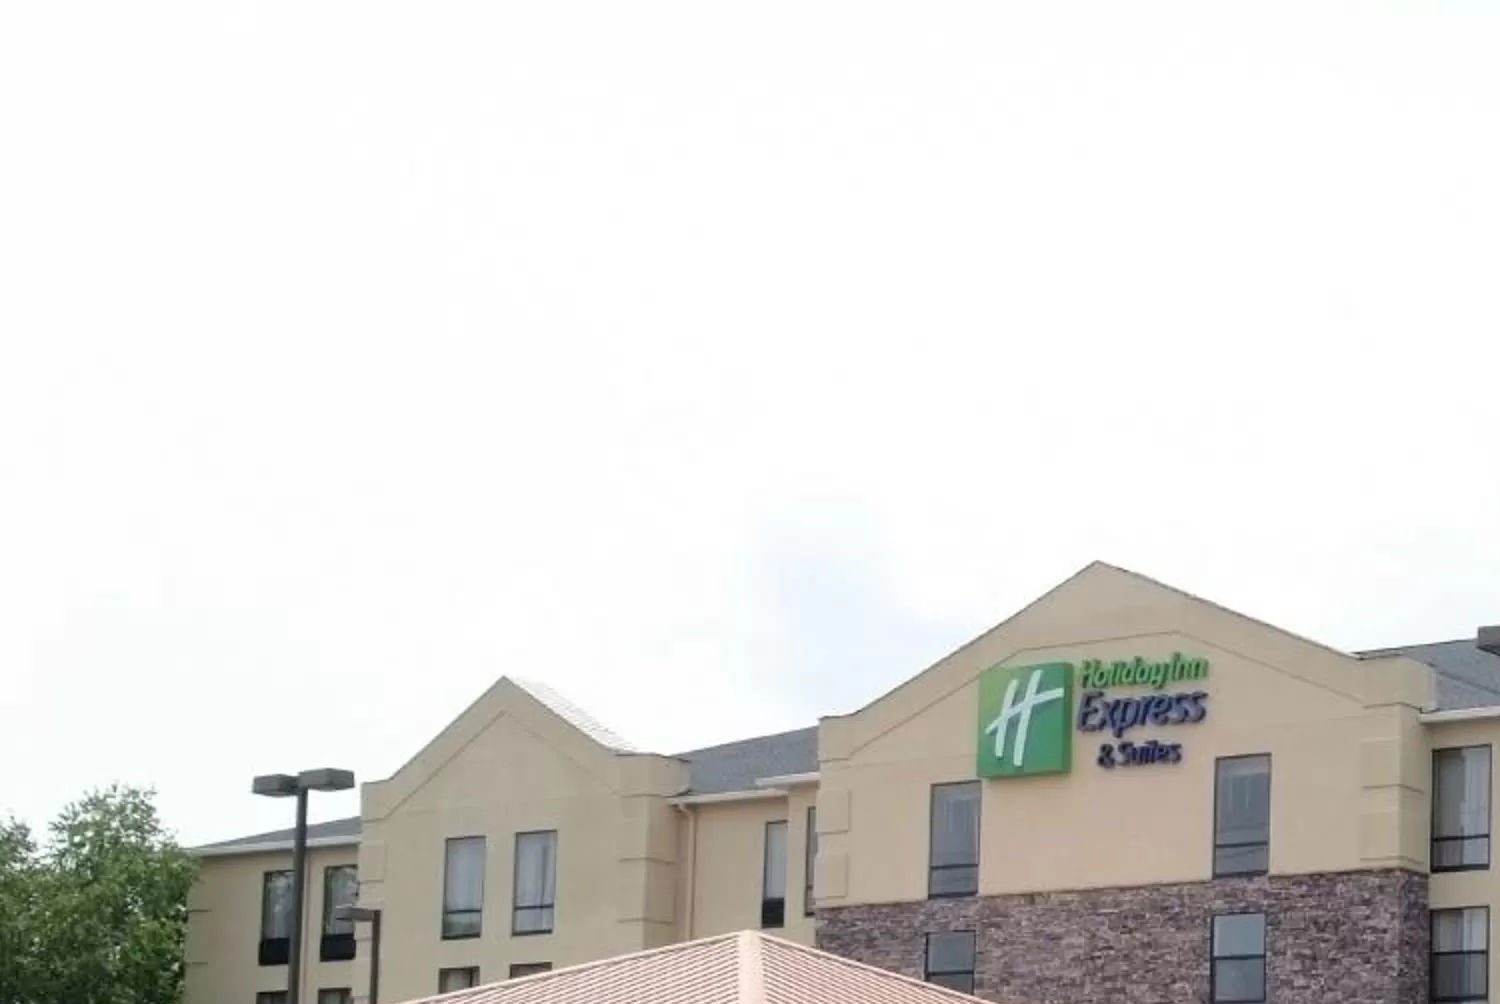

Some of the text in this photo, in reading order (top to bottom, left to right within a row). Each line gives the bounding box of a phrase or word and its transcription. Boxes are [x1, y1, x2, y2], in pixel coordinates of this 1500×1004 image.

[1081, 652, 1208, 690] Holiday Inn
[1078, 689, 1208, 738] Express
[1097, 739, 1183, 768] & Suites
